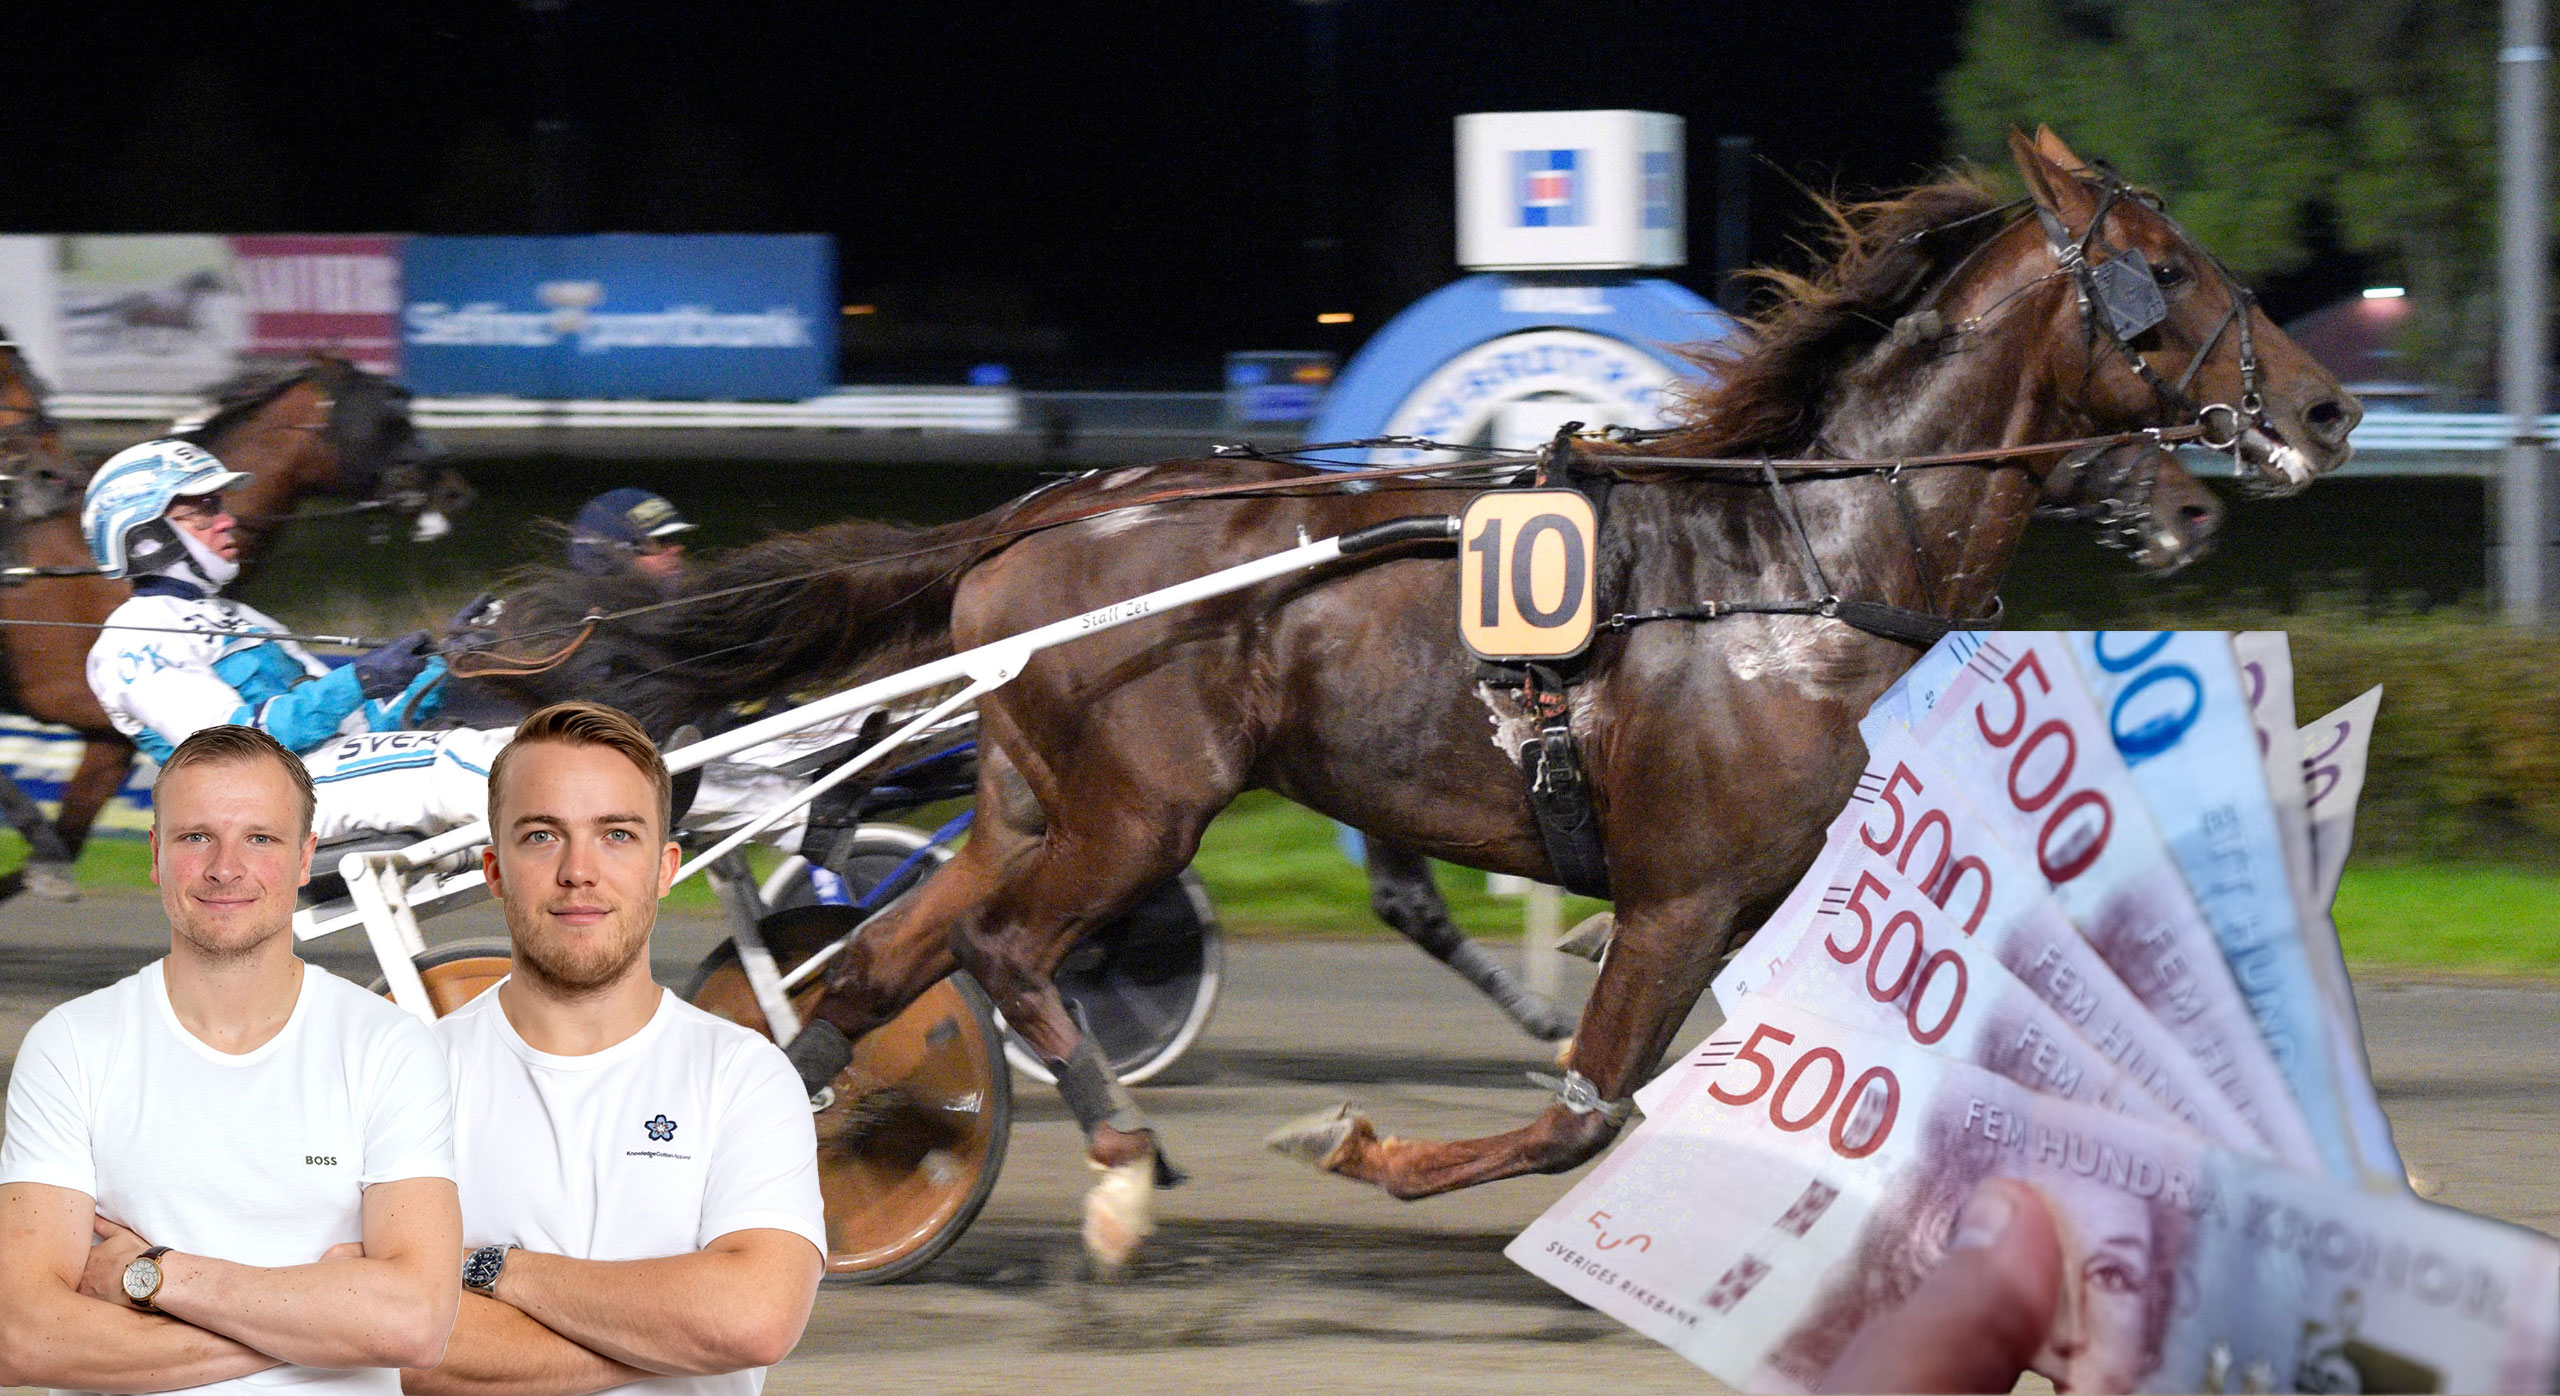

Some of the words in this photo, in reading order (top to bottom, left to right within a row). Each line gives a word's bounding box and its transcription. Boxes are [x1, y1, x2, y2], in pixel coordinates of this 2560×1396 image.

[1468, 513, 1586, 629] 10
[1082, 606, 1119, 629] Stall
[1975, 647, 2113, 884] 500
[1859, 760, 1993, 937] 500
[1824, 869, 1968, 1046] 500
[2034, 942, 2102, 1029] FEM
[1707, 1023, 1900, 1159] 500
[2015, 1021, 2084, 1102] FEM
[305, 1155, 338, 1166] BOSS
[1963, 1097, 2028, 1154] FEM
[1545, 1241, 1619, 1286] SVERIGES
[1618, 1279, 1698, 1329] RIKSBANK
